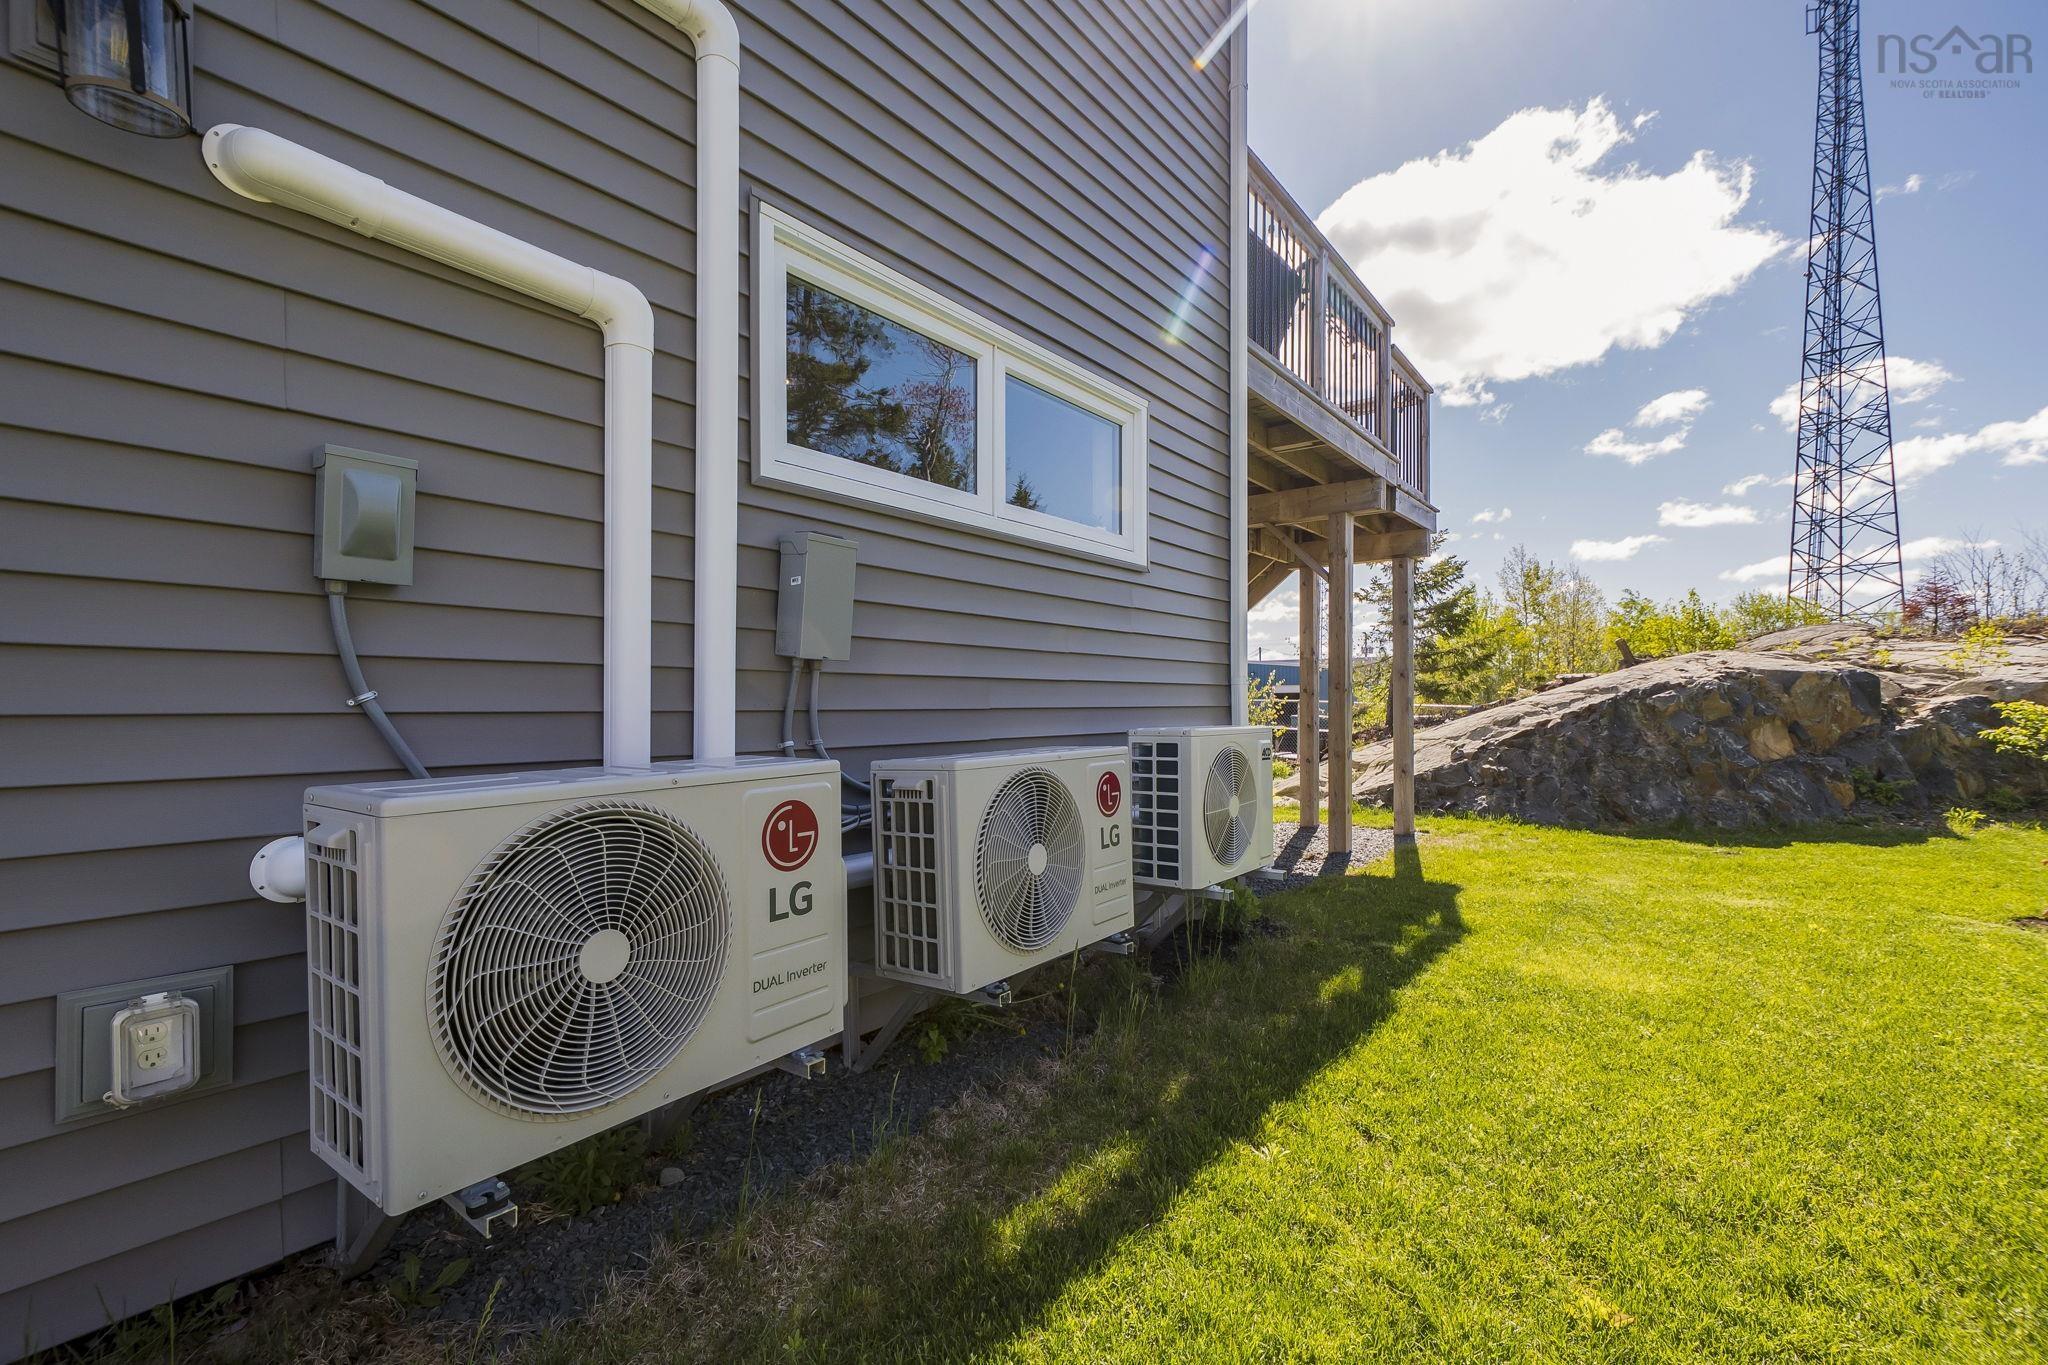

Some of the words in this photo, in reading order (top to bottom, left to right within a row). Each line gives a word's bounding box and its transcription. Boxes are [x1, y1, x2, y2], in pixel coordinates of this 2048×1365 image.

[1100, 824, 1121, 850] LG
[769, 880, 813, 923] LG
[1094, 882, 1109, 895] DUAL
[1109, 878, 1127, 890] Inverter
[753, 973, 785, 994] DUAL
[786, 960, 828, 982] Inverter
